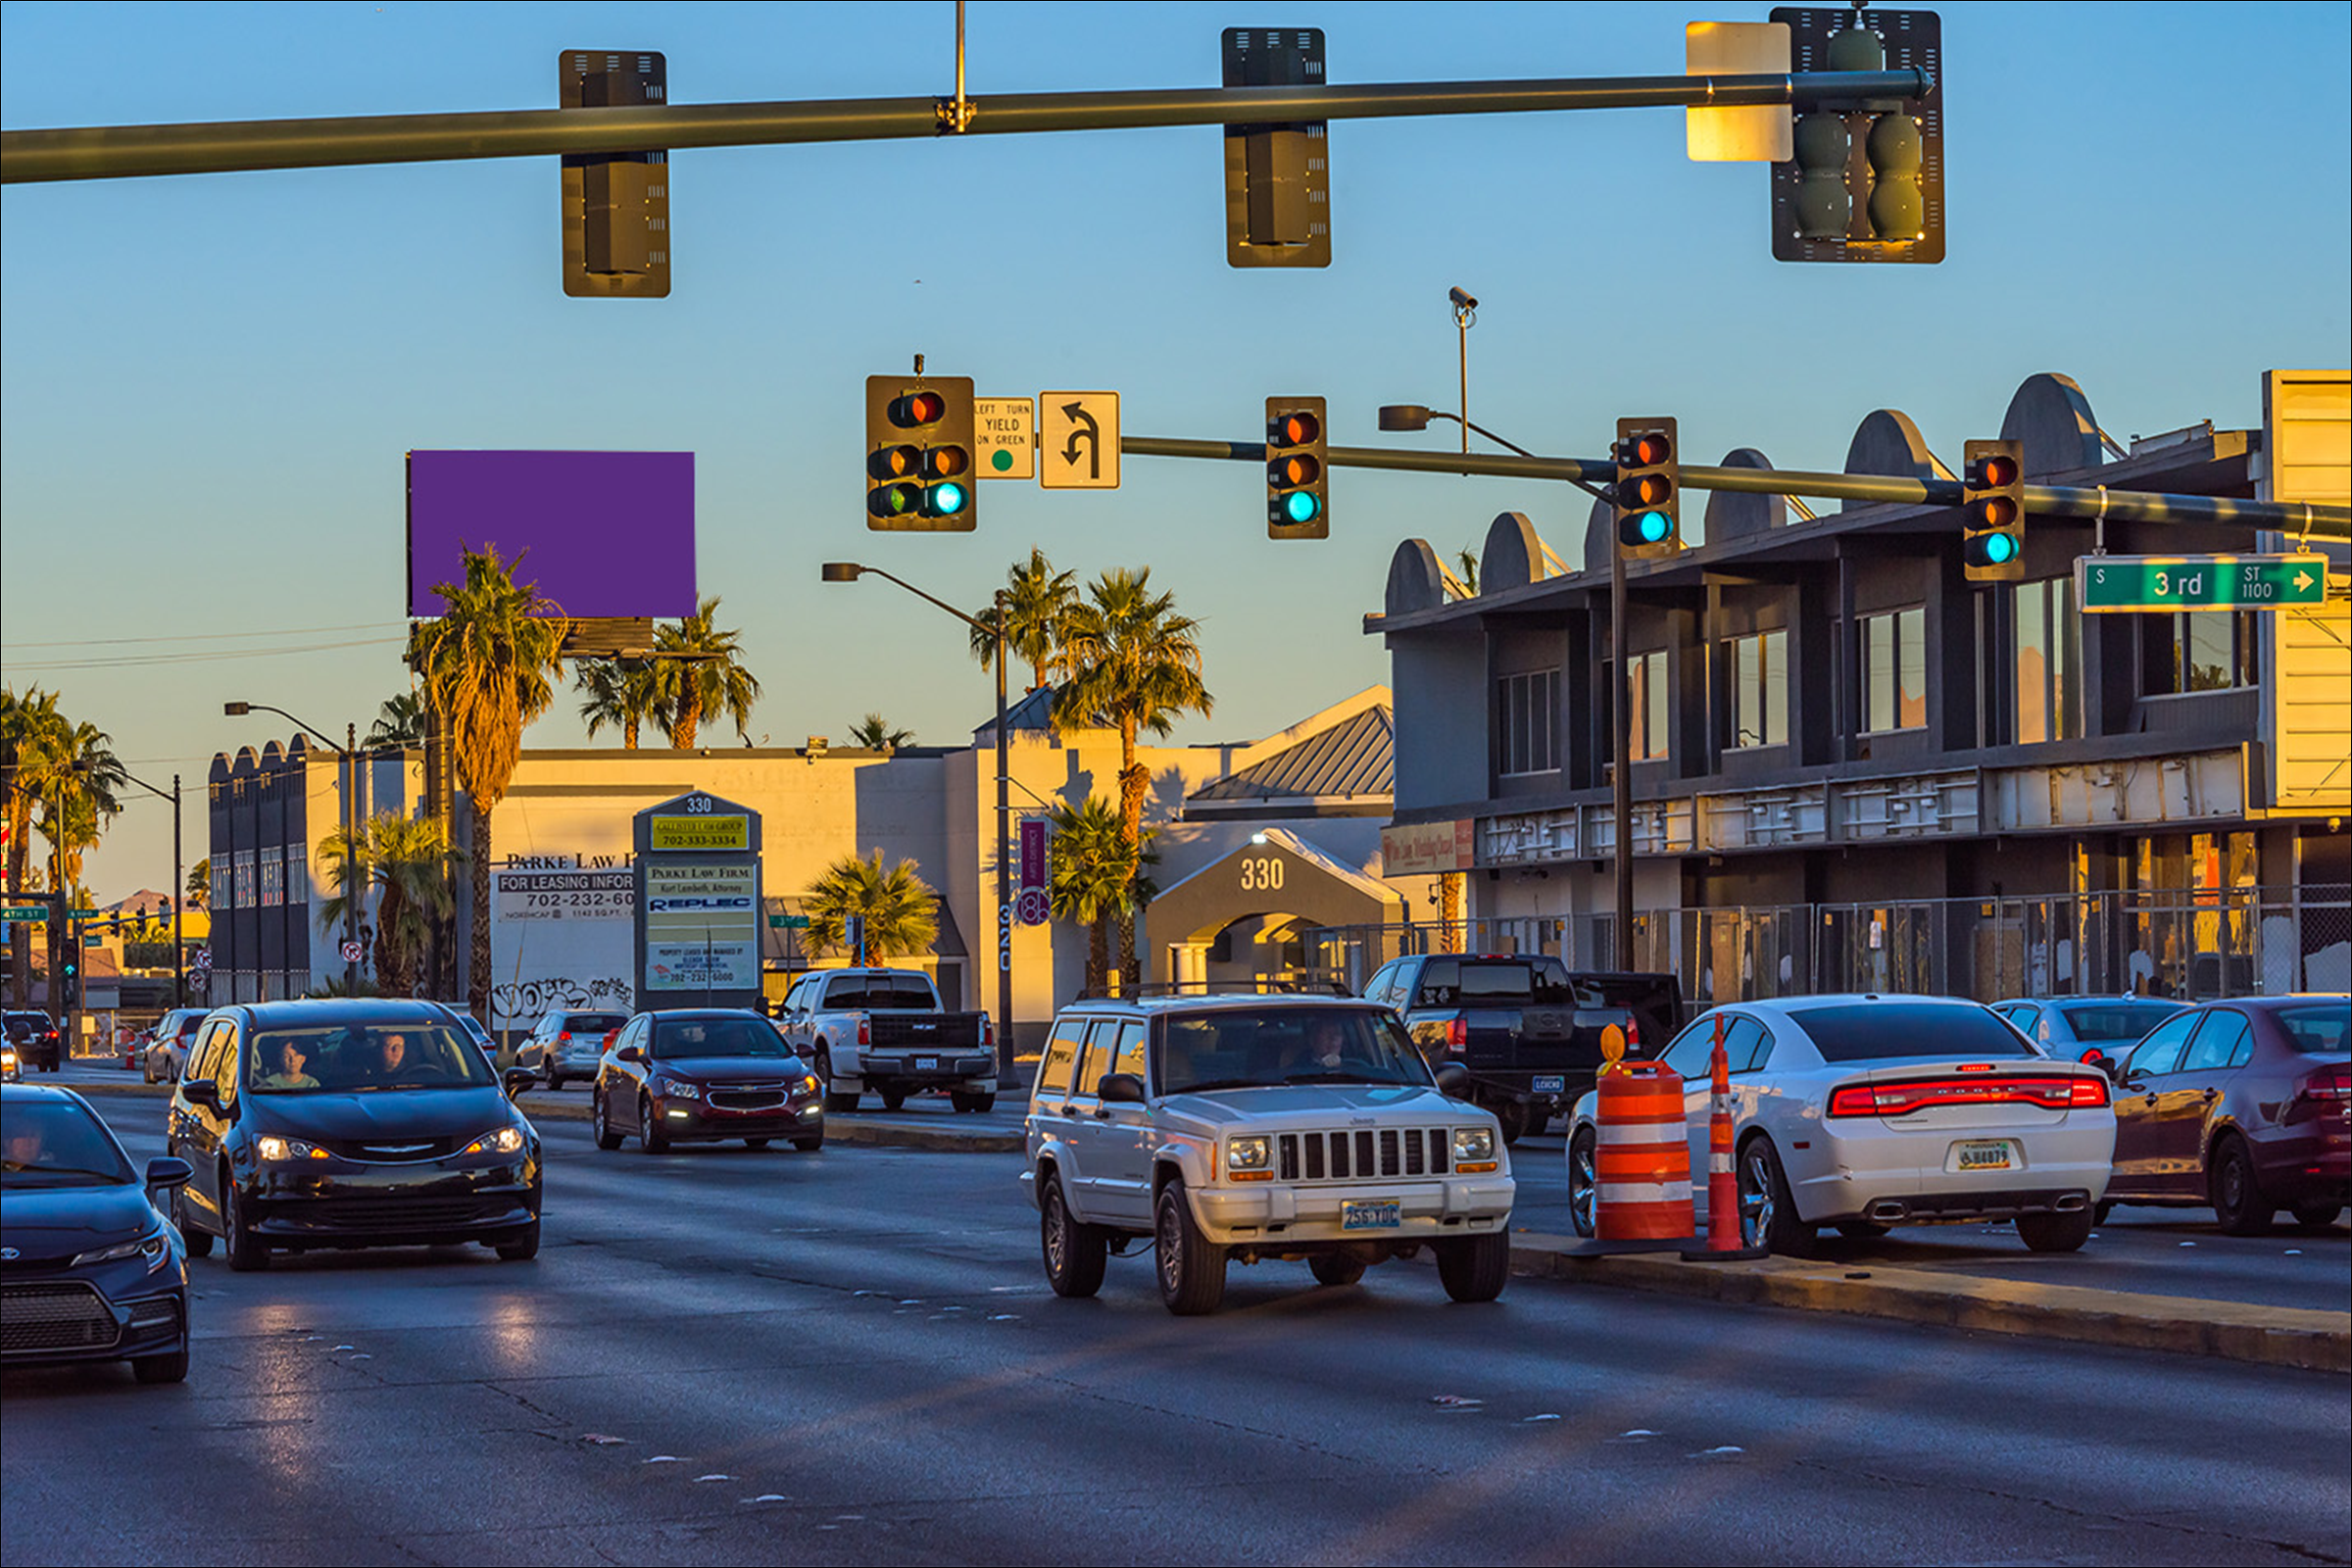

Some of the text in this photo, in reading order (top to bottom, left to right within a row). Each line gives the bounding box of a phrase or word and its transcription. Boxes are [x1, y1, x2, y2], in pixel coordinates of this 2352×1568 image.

[1006, 405, 1030, 415] TURN
[985, 418, 1020, 431] YIELD
[976, 435, 1025, 445] ON GREEN
[2095, 569, 2105, 584] S
[2245, 566, 2261, 581] ST
[2243, 583, 2273, 599] 1100
[687, 798, 712, 812] 330
[662, 836, 737, 845] 702-333-3334
[507, 854, 568, 869] PARKE
[575, 853, 615, 868] LAW
[652, 867, 749, 878] PARKE LAW FIRM
[1241, 858, 1284, 891] 330
[501, 876, 528, 890] FOR
[532, 875, 588, 890] LEASING
[649, 898, 751, 911] REPLEC
[1000, 905, 1010, 970] 320
